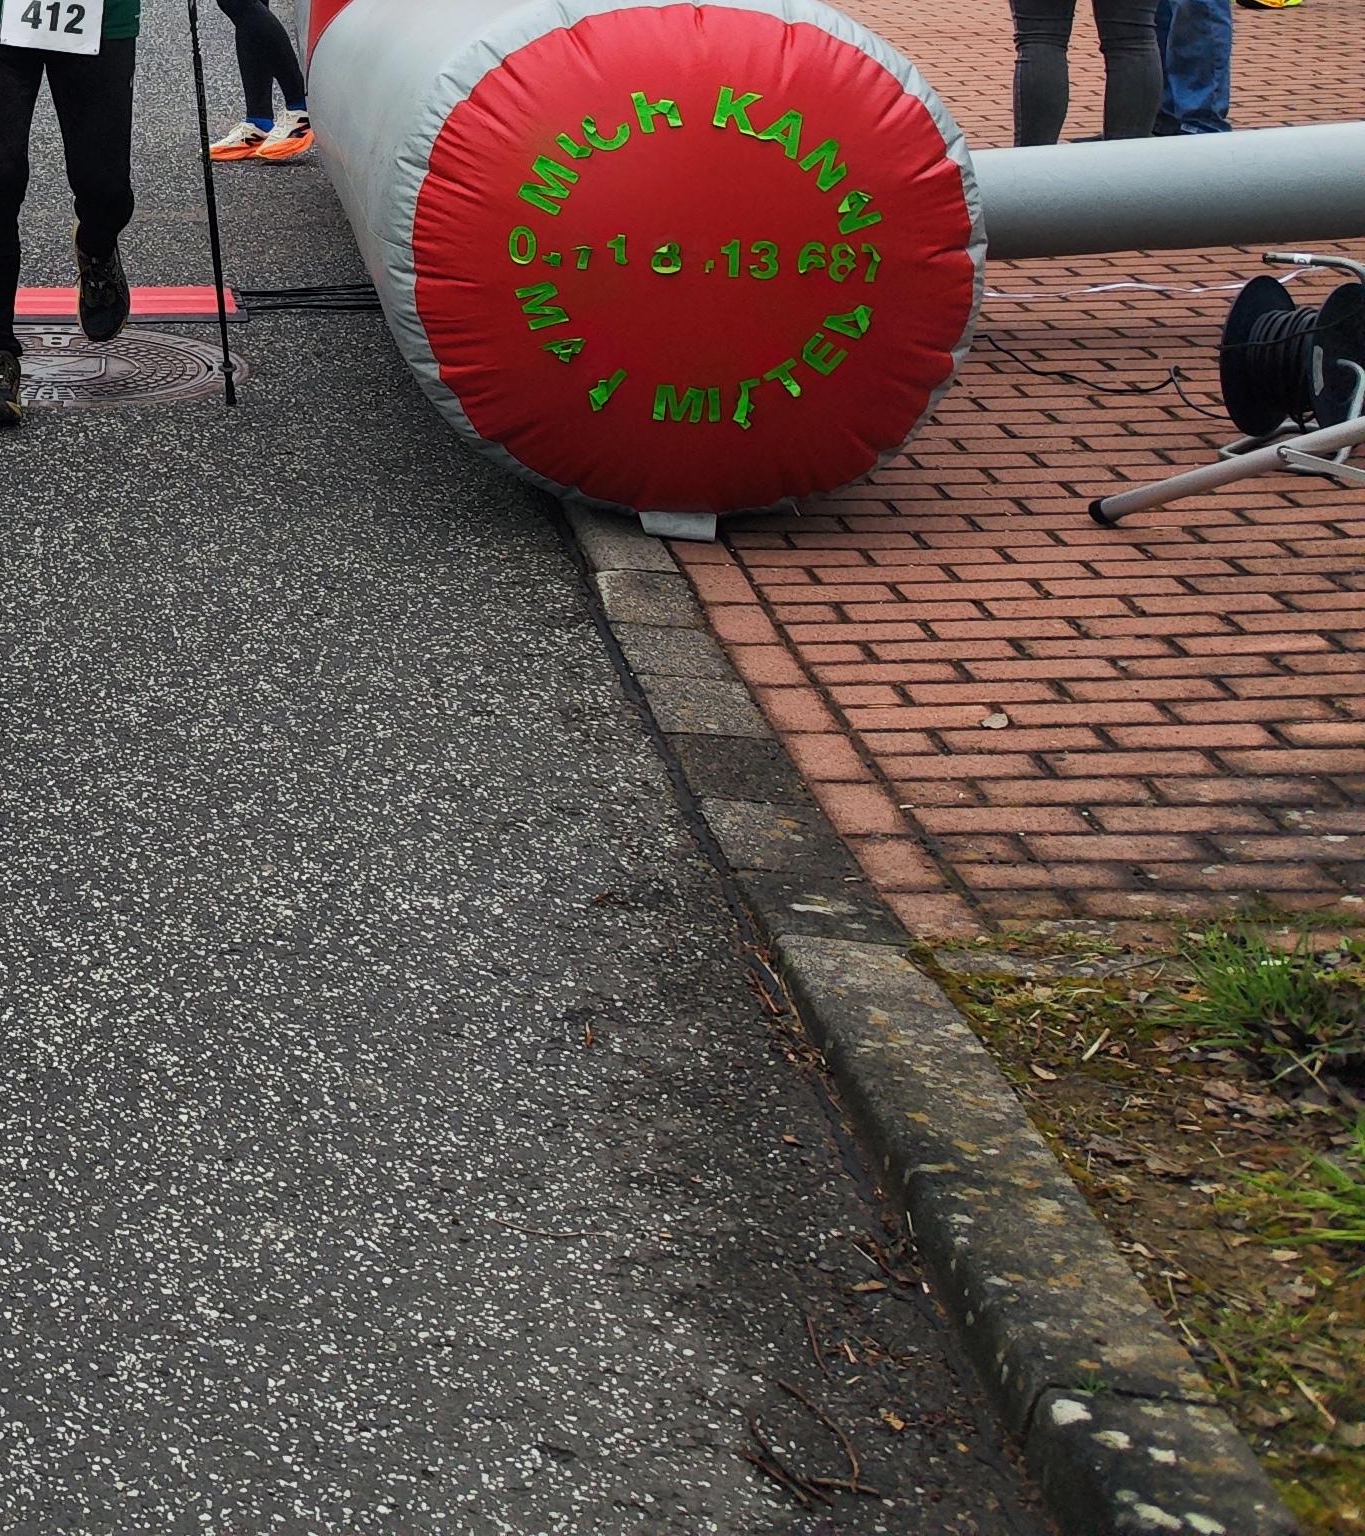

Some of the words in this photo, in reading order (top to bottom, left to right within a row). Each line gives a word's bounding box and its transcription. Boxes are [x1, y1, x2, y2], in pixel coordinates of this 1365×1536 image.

[20, 0, 86, 34] 412
[517, 91, 683, 216] MICH
[712, 86, 882, 235] KANN
